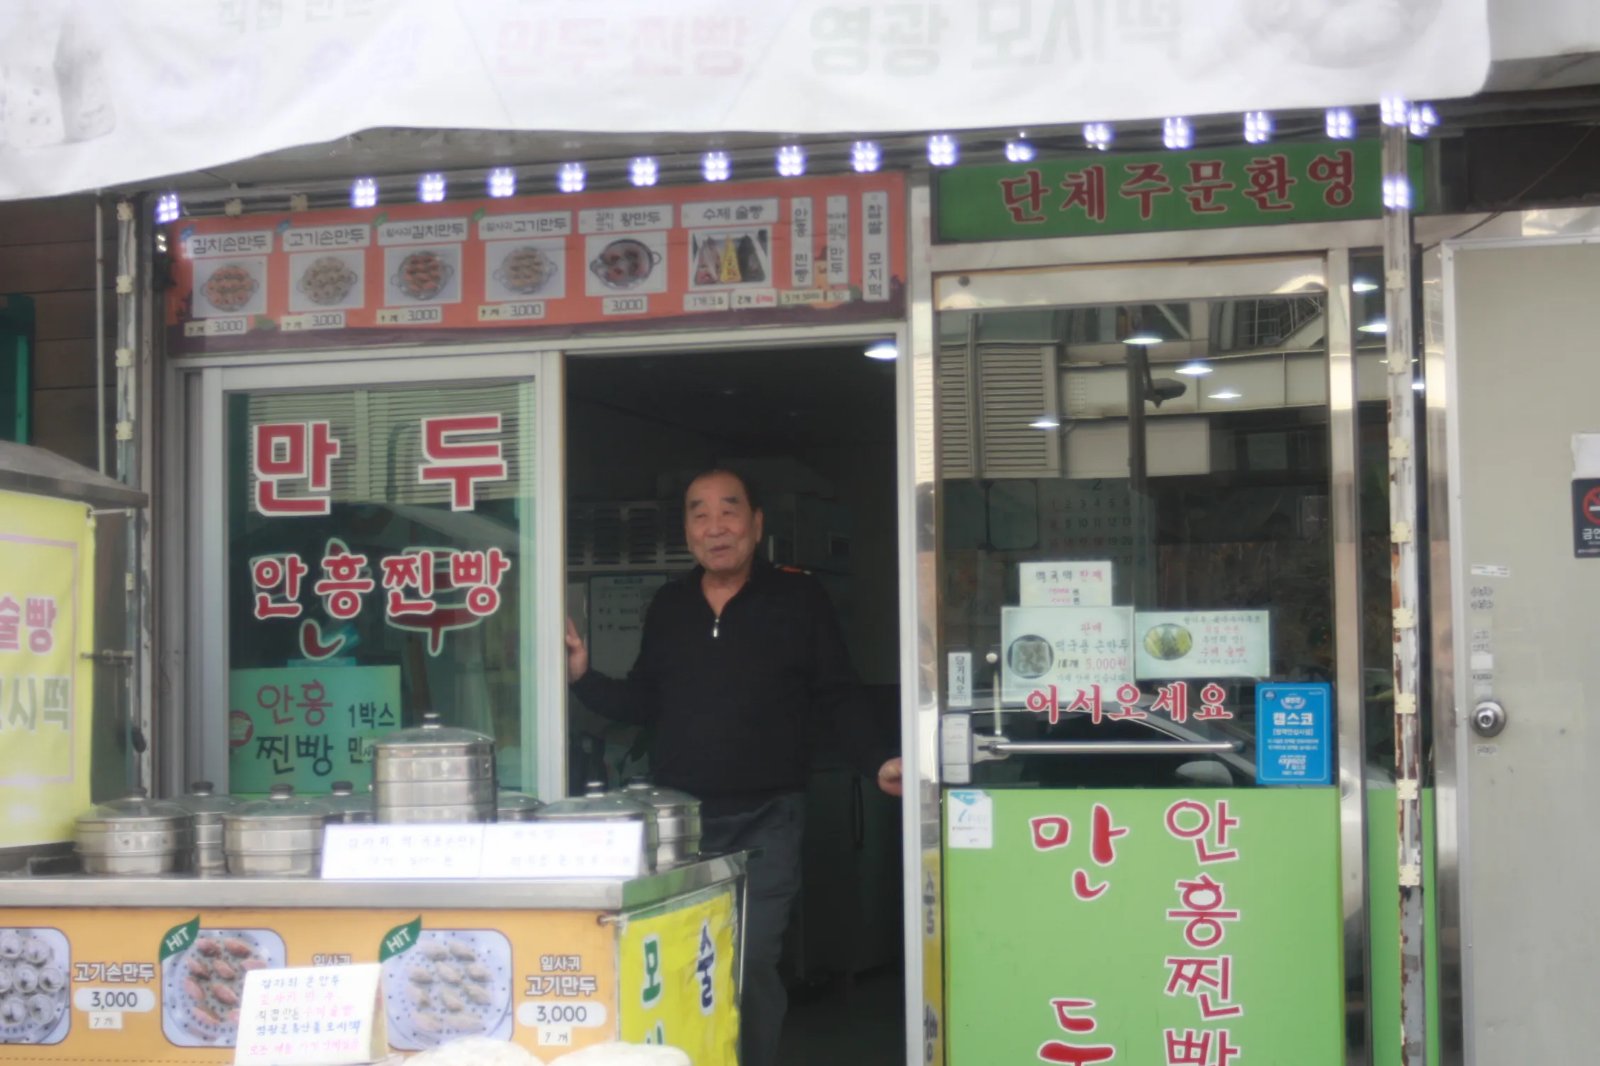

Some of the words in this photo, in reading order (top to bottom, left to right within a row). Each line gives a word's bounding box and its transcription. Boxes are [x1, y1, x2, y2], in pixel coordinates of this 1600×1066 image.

[620, 211, 661, 227] 왕만두
[703, 207, 731, 220] 수제
[735, 205, 764, 220] 술빵
[412, 222, 464, 239] 김치만두
[513, 217, 567, 233] 고기만두
[193, 235, 267, 255] 김치손만두
[290, 228, 365, 247] 고기손만두
[0, 677, 70, 731] 시떡
[256, 679, 334, 727] 안흥
[1026, 681, 1234, 726] 어서오세요
[256, 733, 334, 777] 찐빵
[166, 927, 190, 951] HIT
[386, 928, 412, 954] HIT
[73, 963, 156, 983] 고기손만두
[525, 976, 598, 997] 고기만두
[91, 991, 138, 1010] 3,000
[536, 1005, 588, 1025] 3,000
